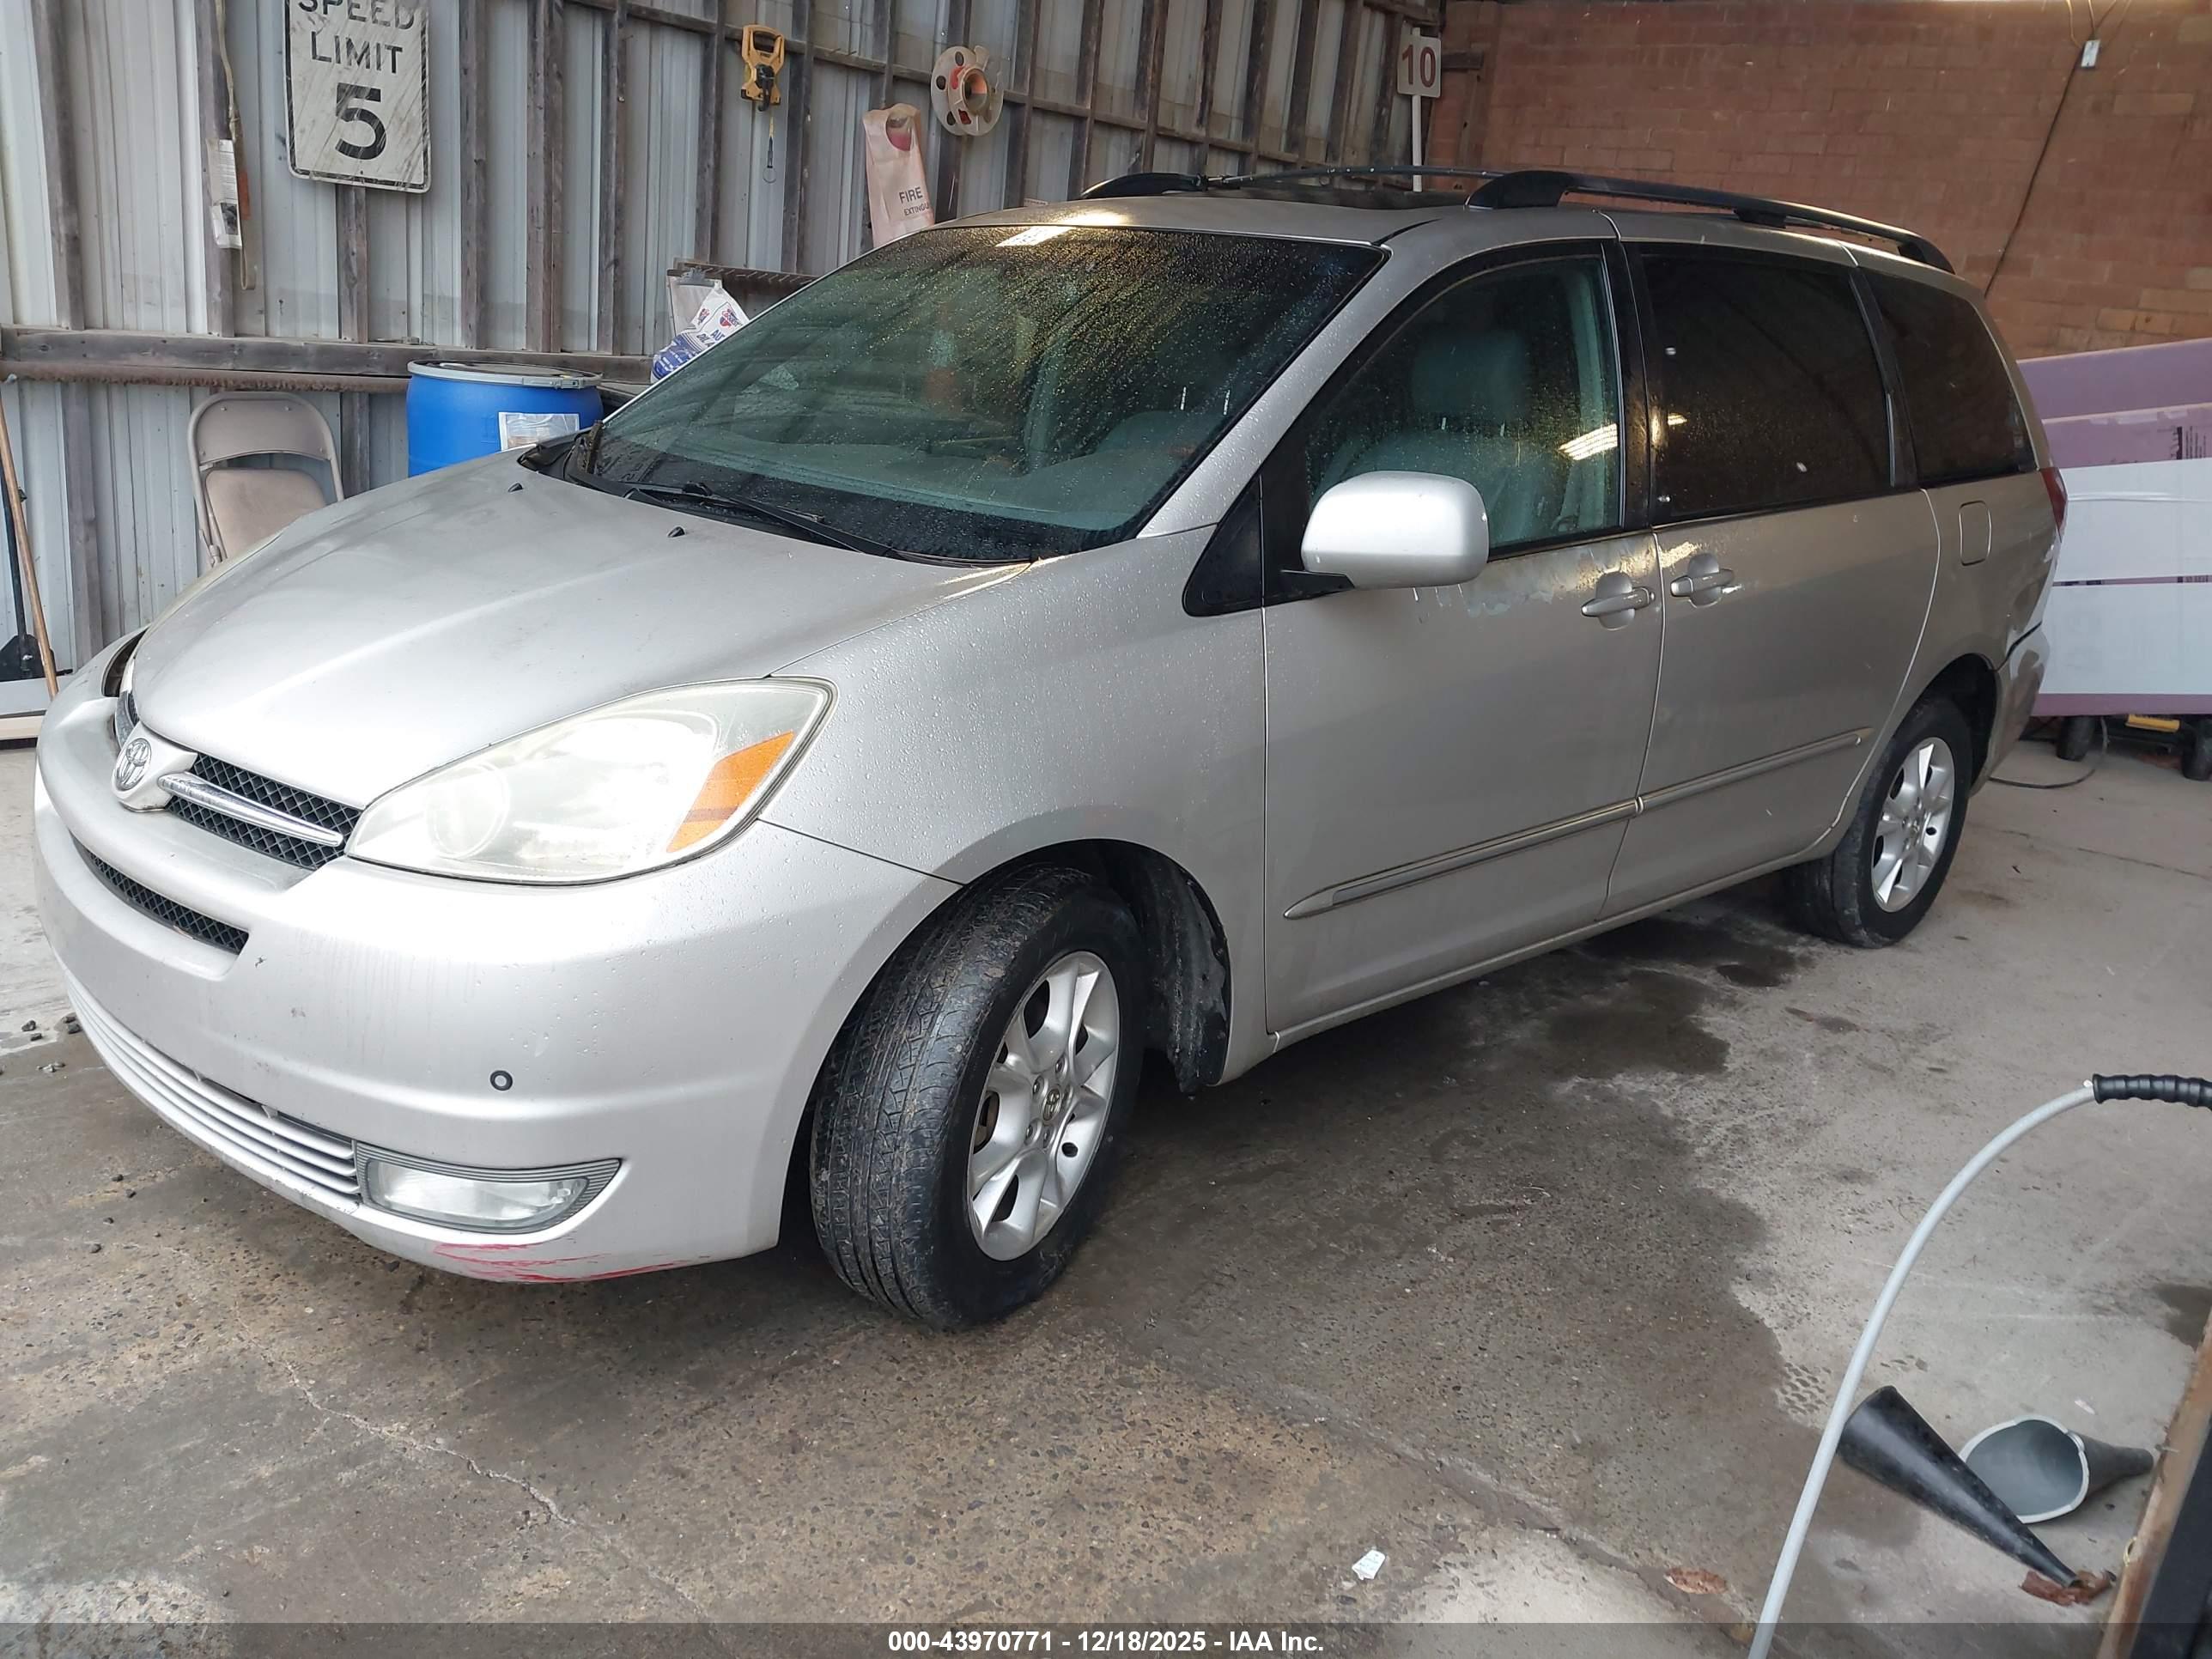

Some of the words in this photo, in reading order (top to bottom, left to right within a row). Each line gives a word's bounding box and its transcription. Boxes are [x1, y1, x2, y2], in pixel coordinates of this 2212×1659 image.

[311, 31, 403, 74] LIMIT
[1402, 45, 1436, 88] 10
[335, 82, 386, 161] 5
[899, 186, 923, 204] FIRE
